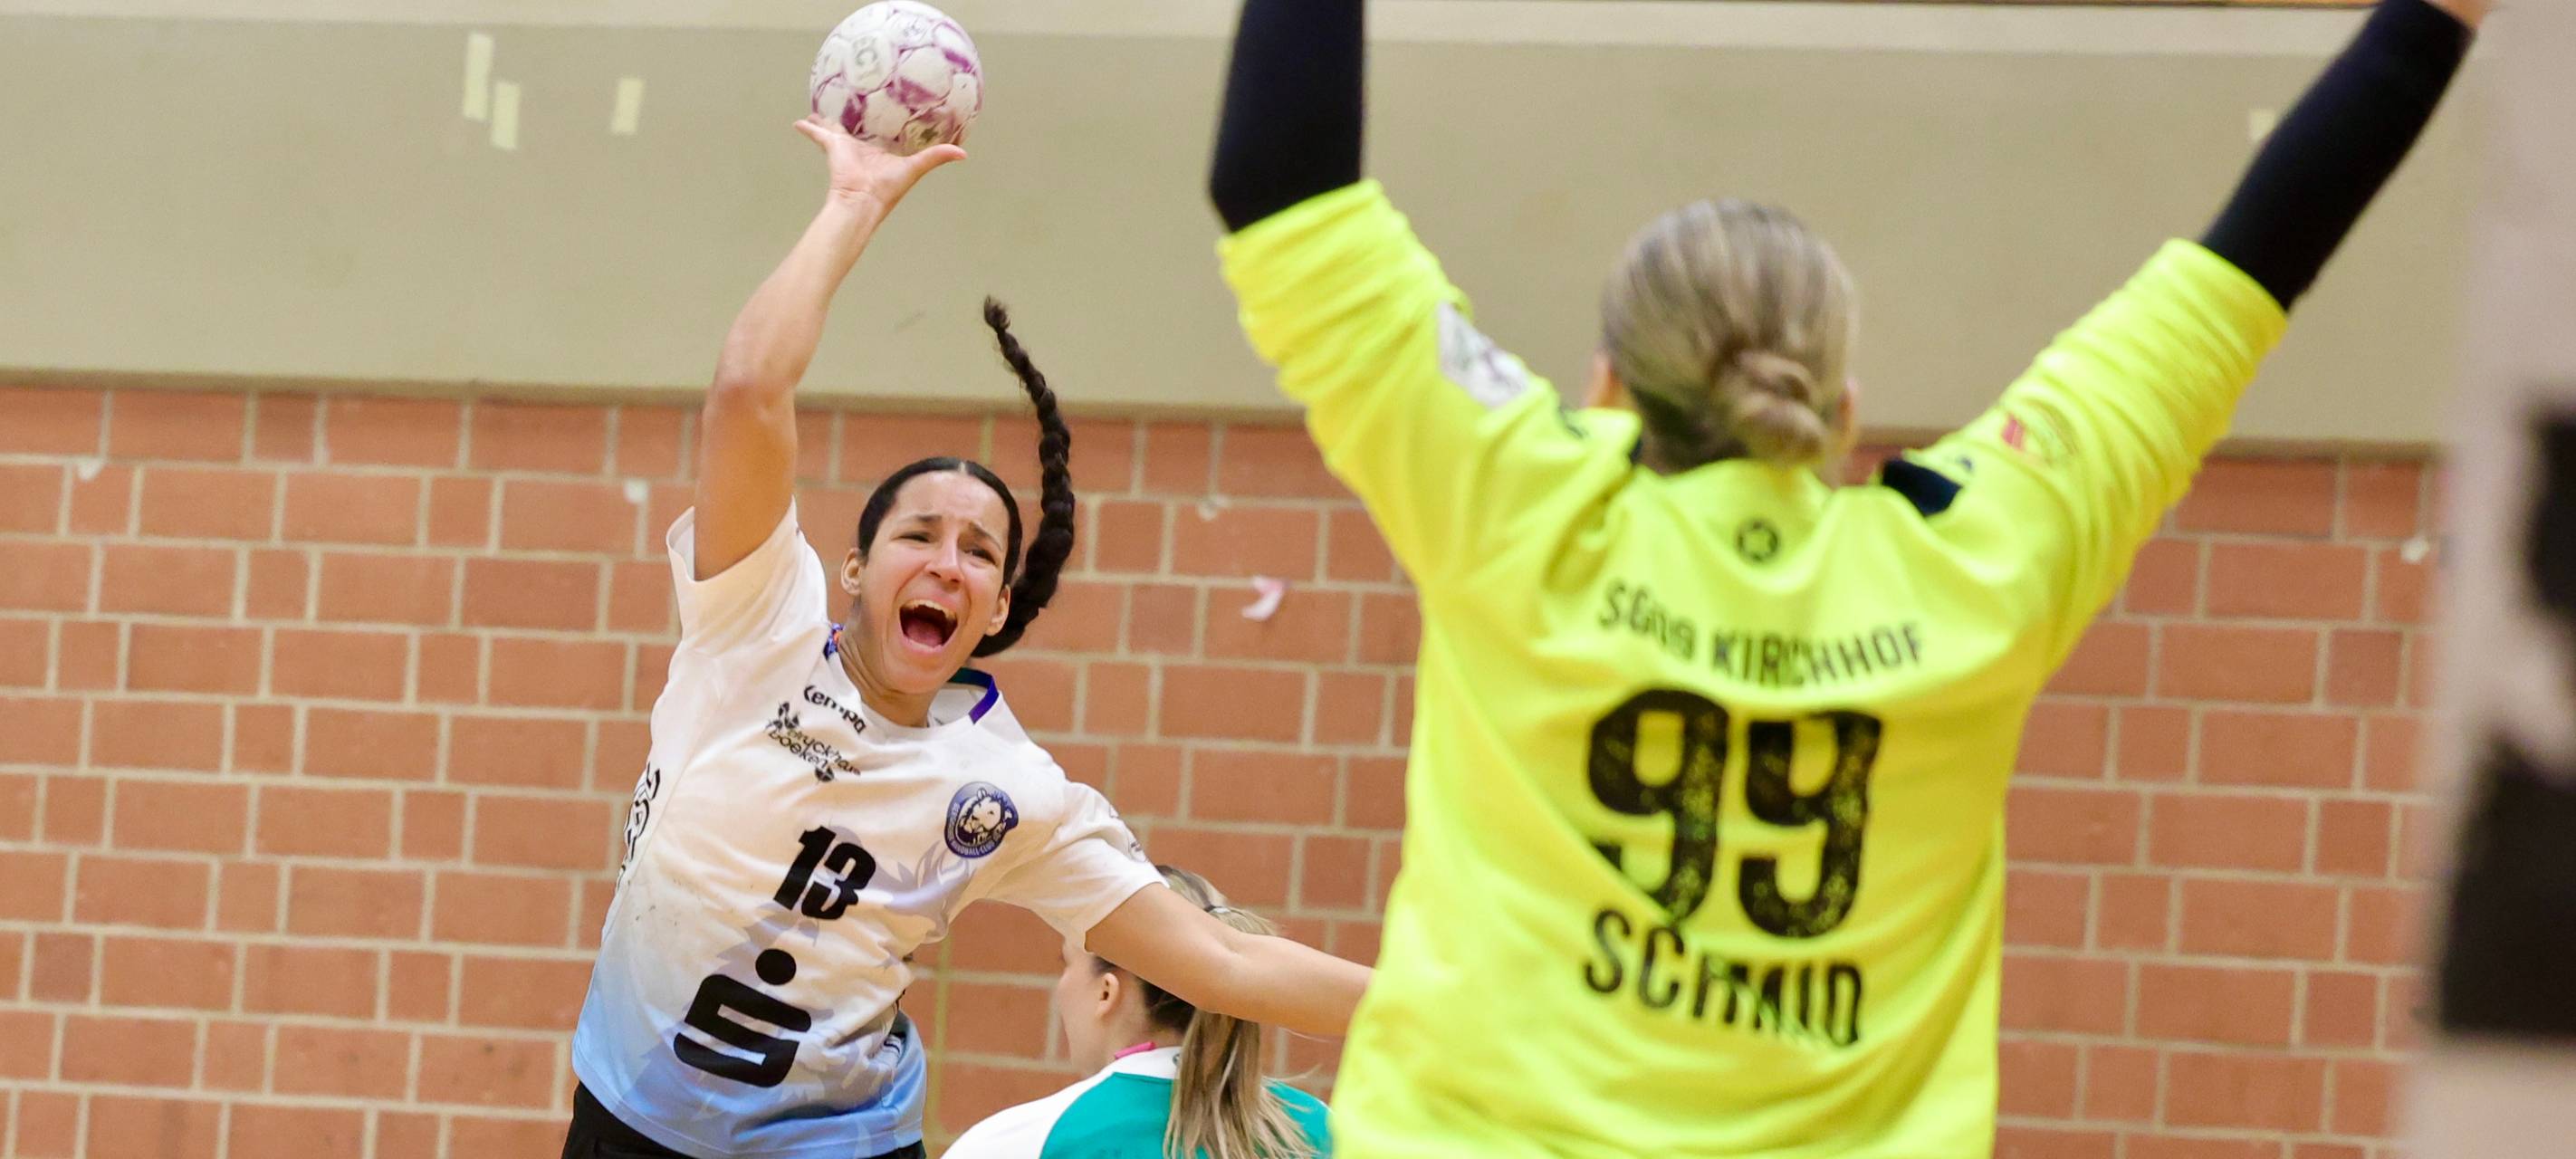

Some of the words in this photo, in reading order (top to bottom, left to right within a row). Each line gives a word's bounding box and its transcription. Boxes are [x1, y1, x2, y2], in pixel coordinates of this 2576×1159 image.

[774, 826, 876, 920] 13
[1587, 684, 1882, 939] 99
[1585, 908, 1862, 1047] SCHMID
